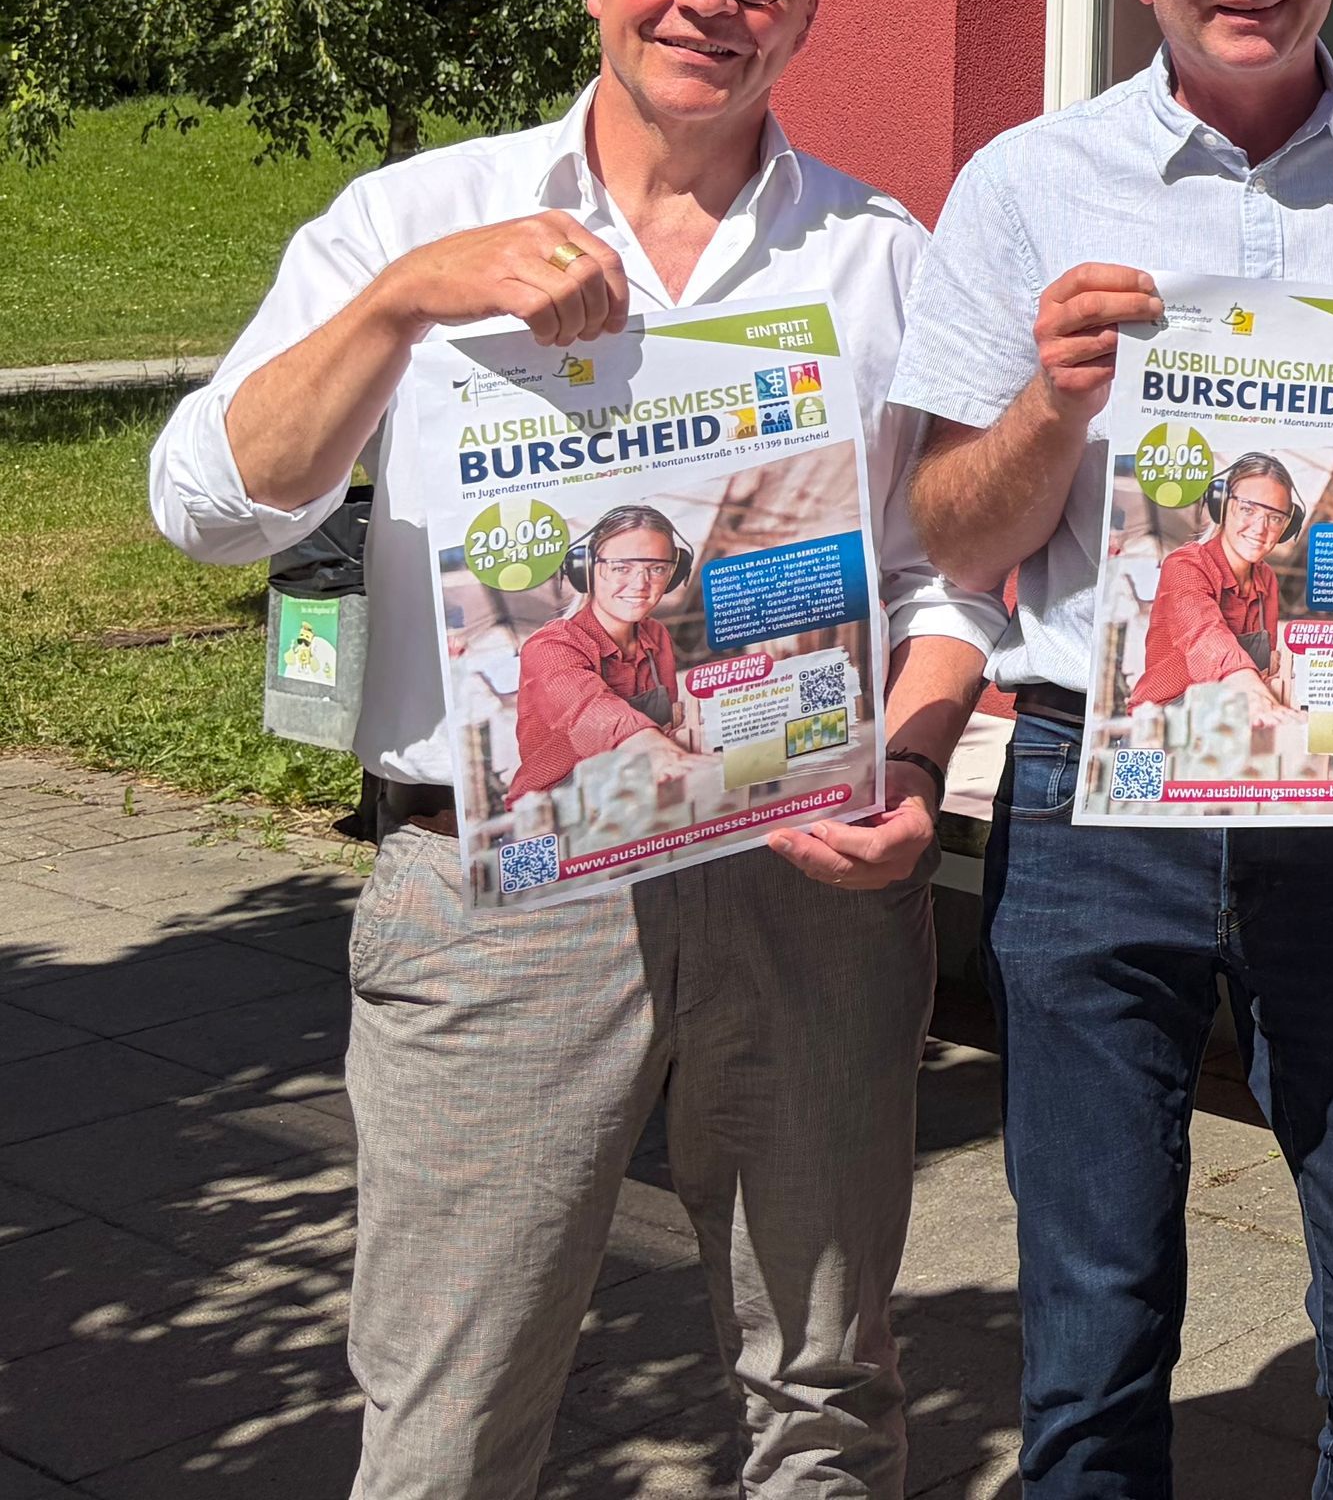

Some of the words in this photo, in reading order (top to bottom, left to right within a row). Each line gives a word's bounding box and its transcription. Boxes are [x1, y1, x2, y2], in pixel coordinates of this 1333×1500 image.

[745, 319, 809, 341] EINTRITT
[778, 332, 813, 347] FREI!
[459, 383, 754, 448] AUSBILDUNGSMESSE
[460, 415, 721, 485] BURSCHEID
[1138, 444, 1208, 465] 20.06.
[462, 490, 476, 499] im
[477, 475, 559, 498] Jugendzentrum
[652, 448, 732, 469] Montanusstraße
[735, 445, 746, 454] 15
[753, 438, 781, 451] 51399
[784, 429, 830, 445] Burscheid
[1141, 468, 1156, 480] 10
[1168, 468, 1181, 480] 14
[1186, 468, 1208, 479] Uhr
[469, 515, 562, 554] 20.06.
[474, 554, 495, 570] 10
[509, 546, 529, 562] 14
[531, 538, 564, 556] Uhr
[1290, 624, 1320, 632] FINDE
[690, 666, 766, 689] BERUFUNG
[692, 663, 728, 678] FINDE
[730, 655, 767, 670] DEINE
[718, 690, 768, 707] MacBook
[769, 684, 794, 696] Neo!
[565, 789, 845, 874] www.ausbildungsmesse-burscheid.de
